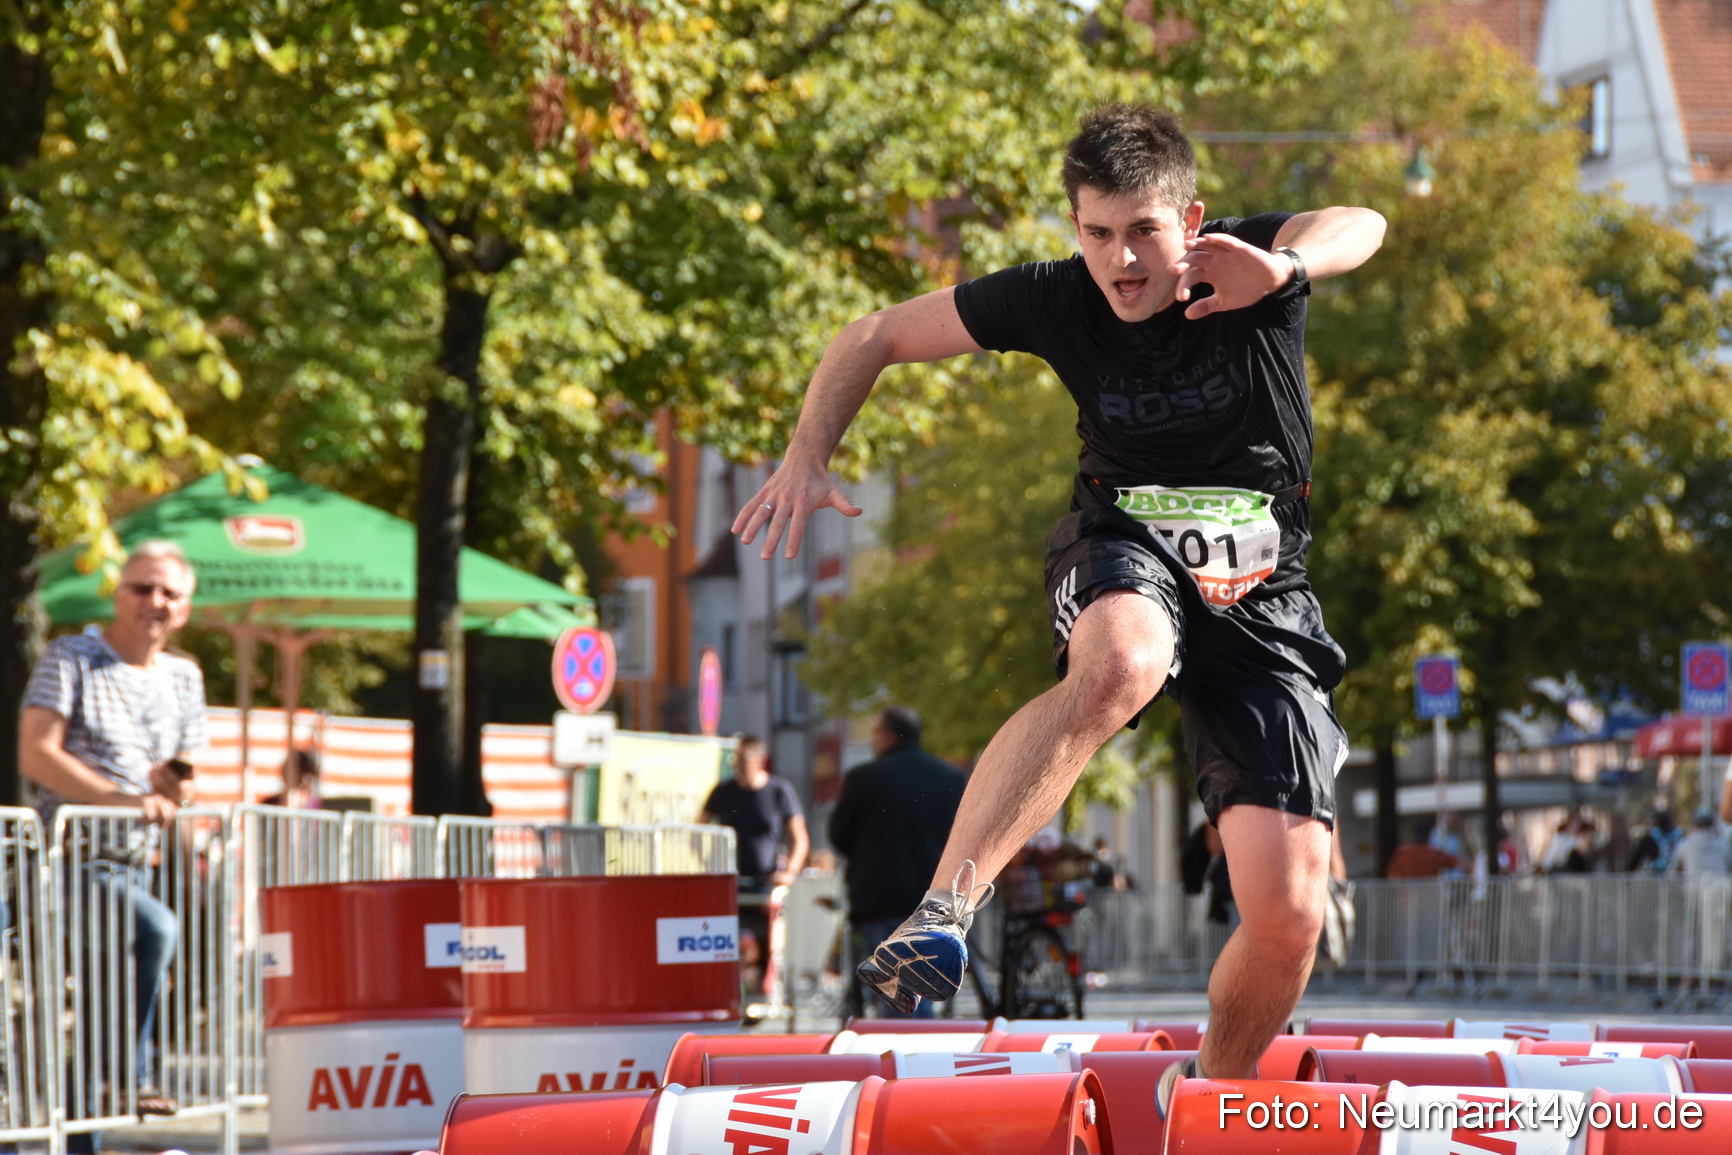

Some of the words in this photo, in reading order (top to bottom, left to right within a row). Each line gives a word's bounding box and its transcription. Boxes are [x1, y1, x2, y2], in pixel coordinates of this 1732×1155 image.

[1096, 345, 1228, 391] VITTORIO
[1098, 362, 1248, 426] ROSSI
[1160, 528, 1239, 569] 01
[1200, 576, 1260, 601] TOPH
